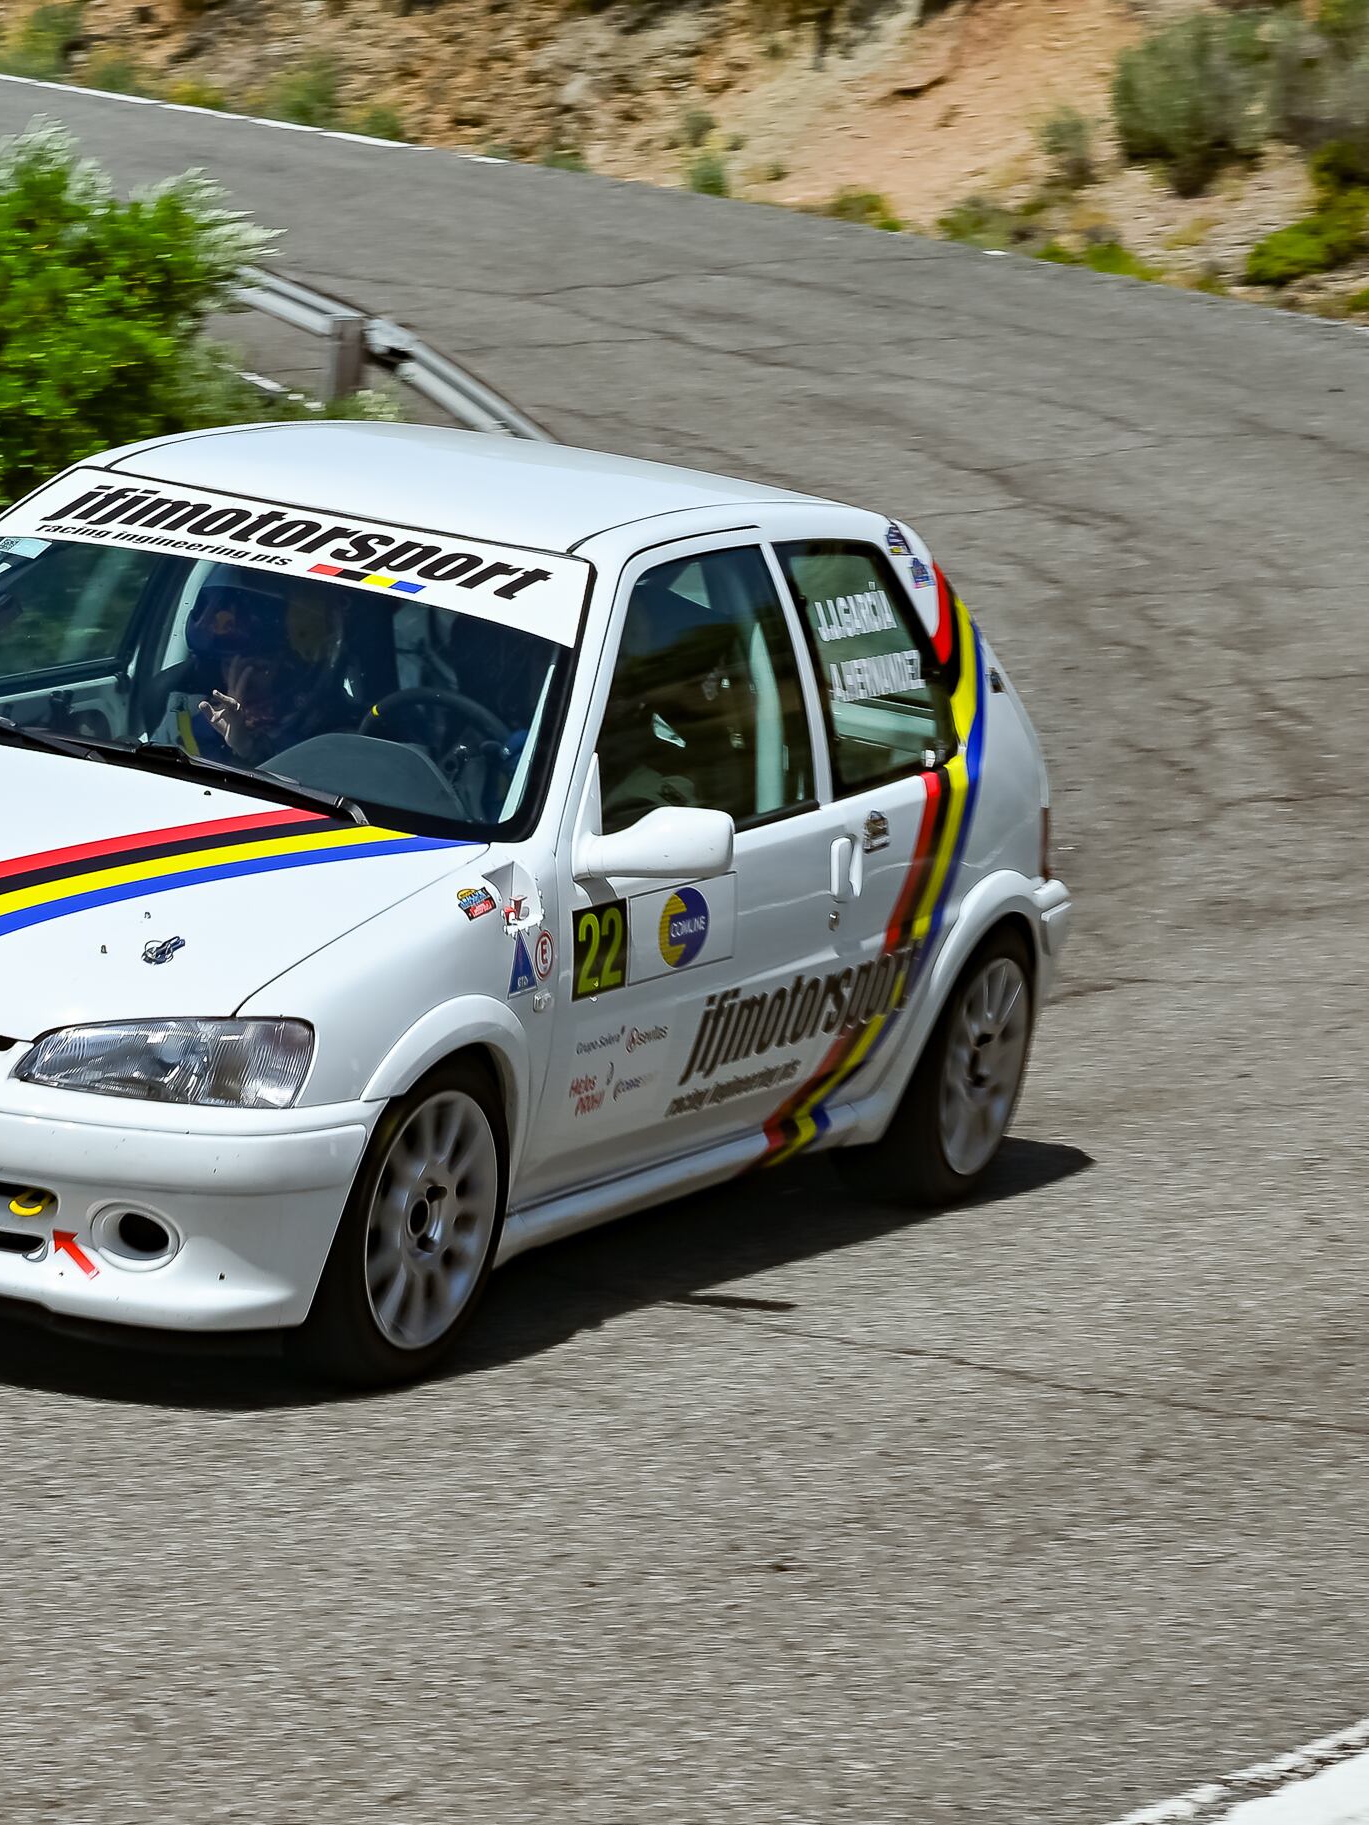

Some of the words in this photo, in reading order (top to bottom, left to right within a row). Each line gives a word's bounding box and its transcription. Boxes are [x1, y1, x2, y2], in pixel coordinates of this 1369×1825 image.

[35, 524, 112, 539] racing
[111, 531, 254, 560] ingineering
[247, 551, 293, 566] pts
[540, 938, 549, 964] E
[577, 907, 623, 994] 22
